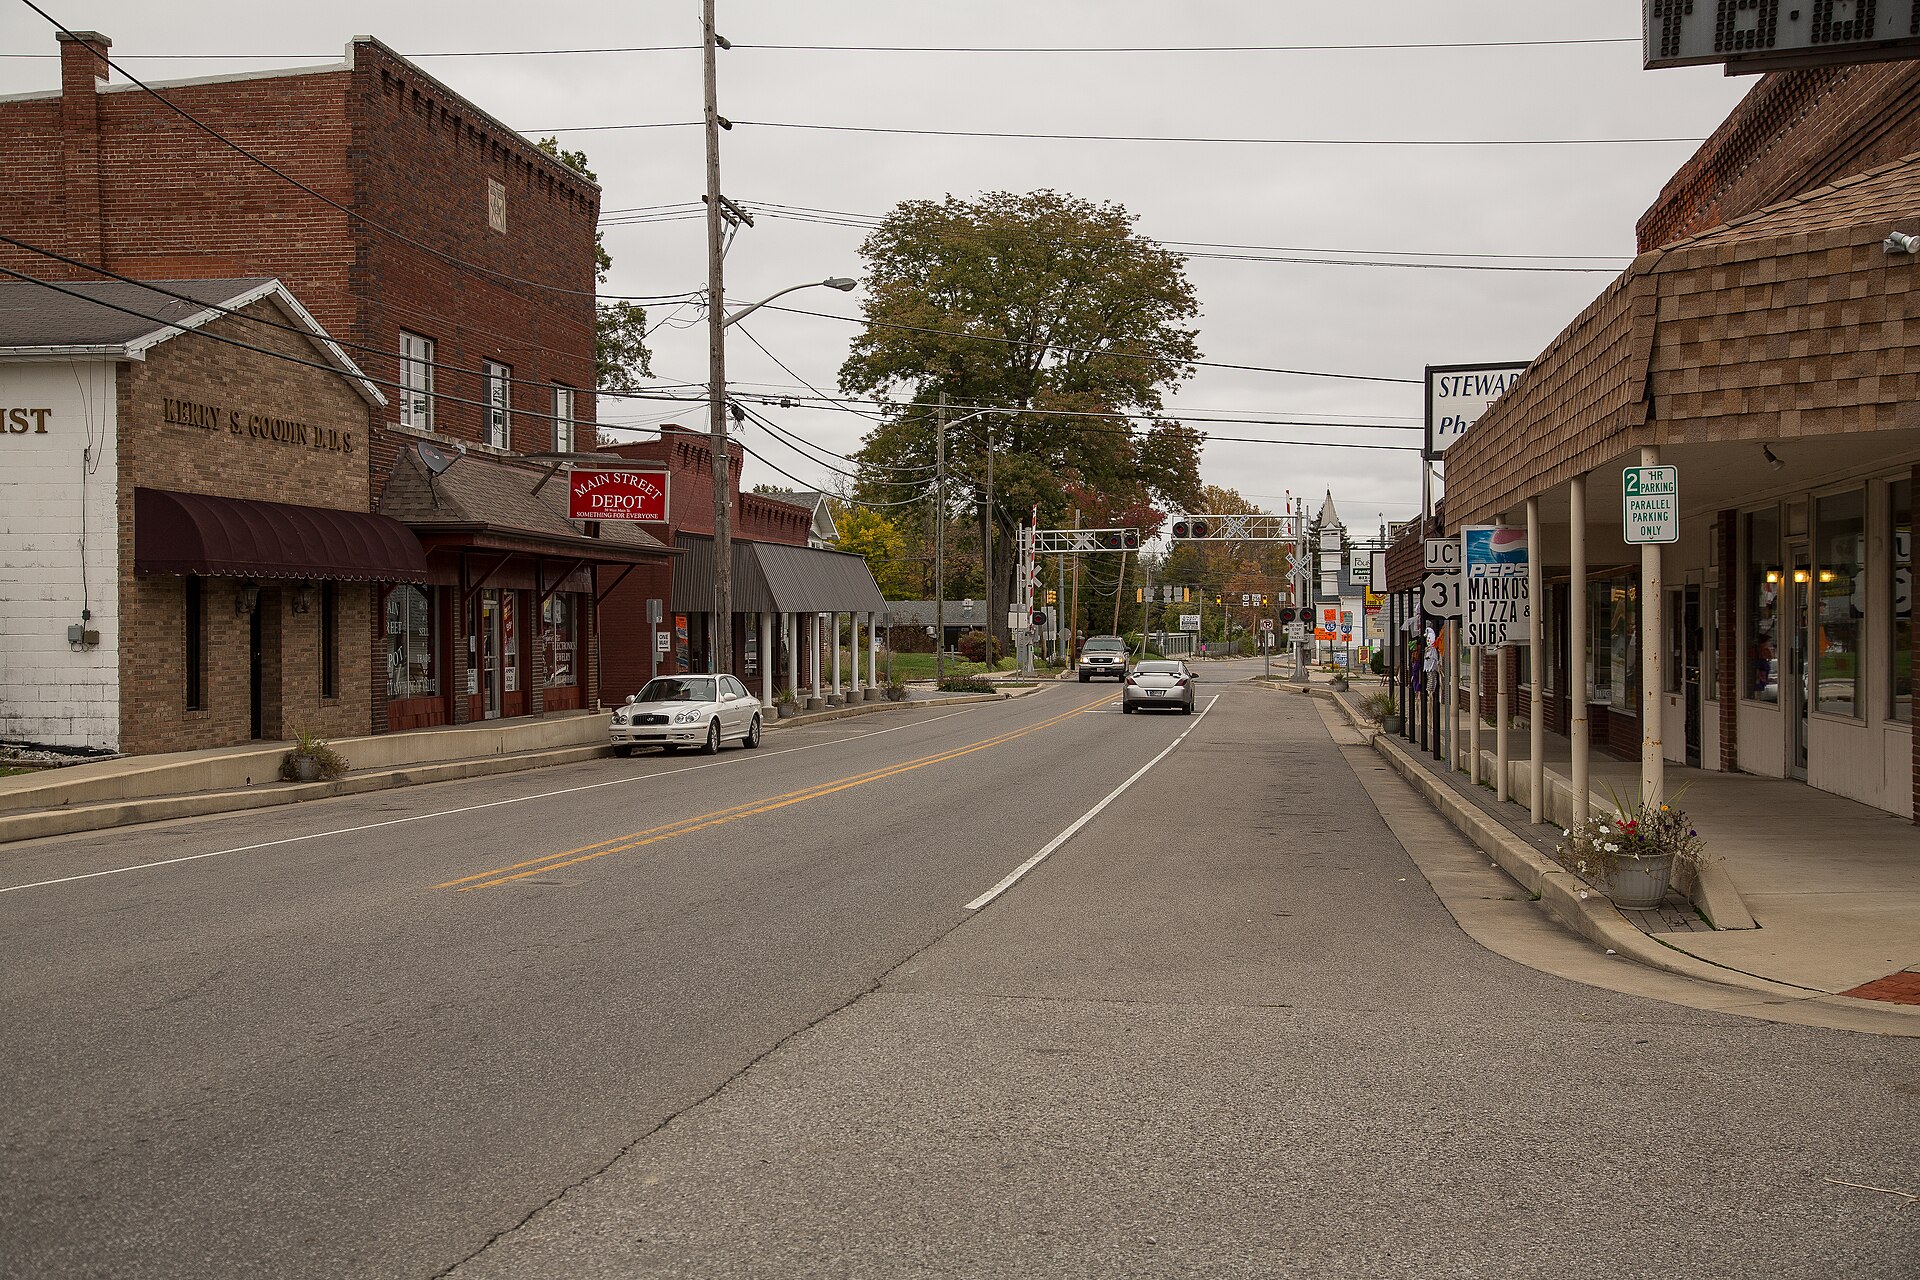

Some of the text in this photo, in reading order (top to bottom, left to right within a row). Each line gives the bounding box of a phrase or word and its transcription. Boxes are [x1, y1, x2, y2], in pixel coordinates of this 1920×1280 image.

[163, 398, 221, 430] KERRY
[229, 409, 242, 434] S.
[249, 414, 308, 445] GOODIN
[1439, 415, 1476, 434] Ph
[574, 472, 662, 500] MAIN STREET
[1626, 471, 1663, 492] 2 HR
[1641, 482, 1673, 493] PARKING
[592, 494, 645, 509] DEPOT
[1631, 499, 1670, 510] PARALLEL
[626, 512, 659, 520] EVERYONE
[1633, 511, 1668, 522] PARKING
[1641, 526, 1661, 536] ONLY
[1286, 554, 1310, 578] CROSSING
[1430, 583, 1460, 608] 31
[1468, 578, 1528, 600] MARKO'S
[1469, 601, 1530, 622] PIZZA &
[1469, 623, 1507, 645] SUBS
